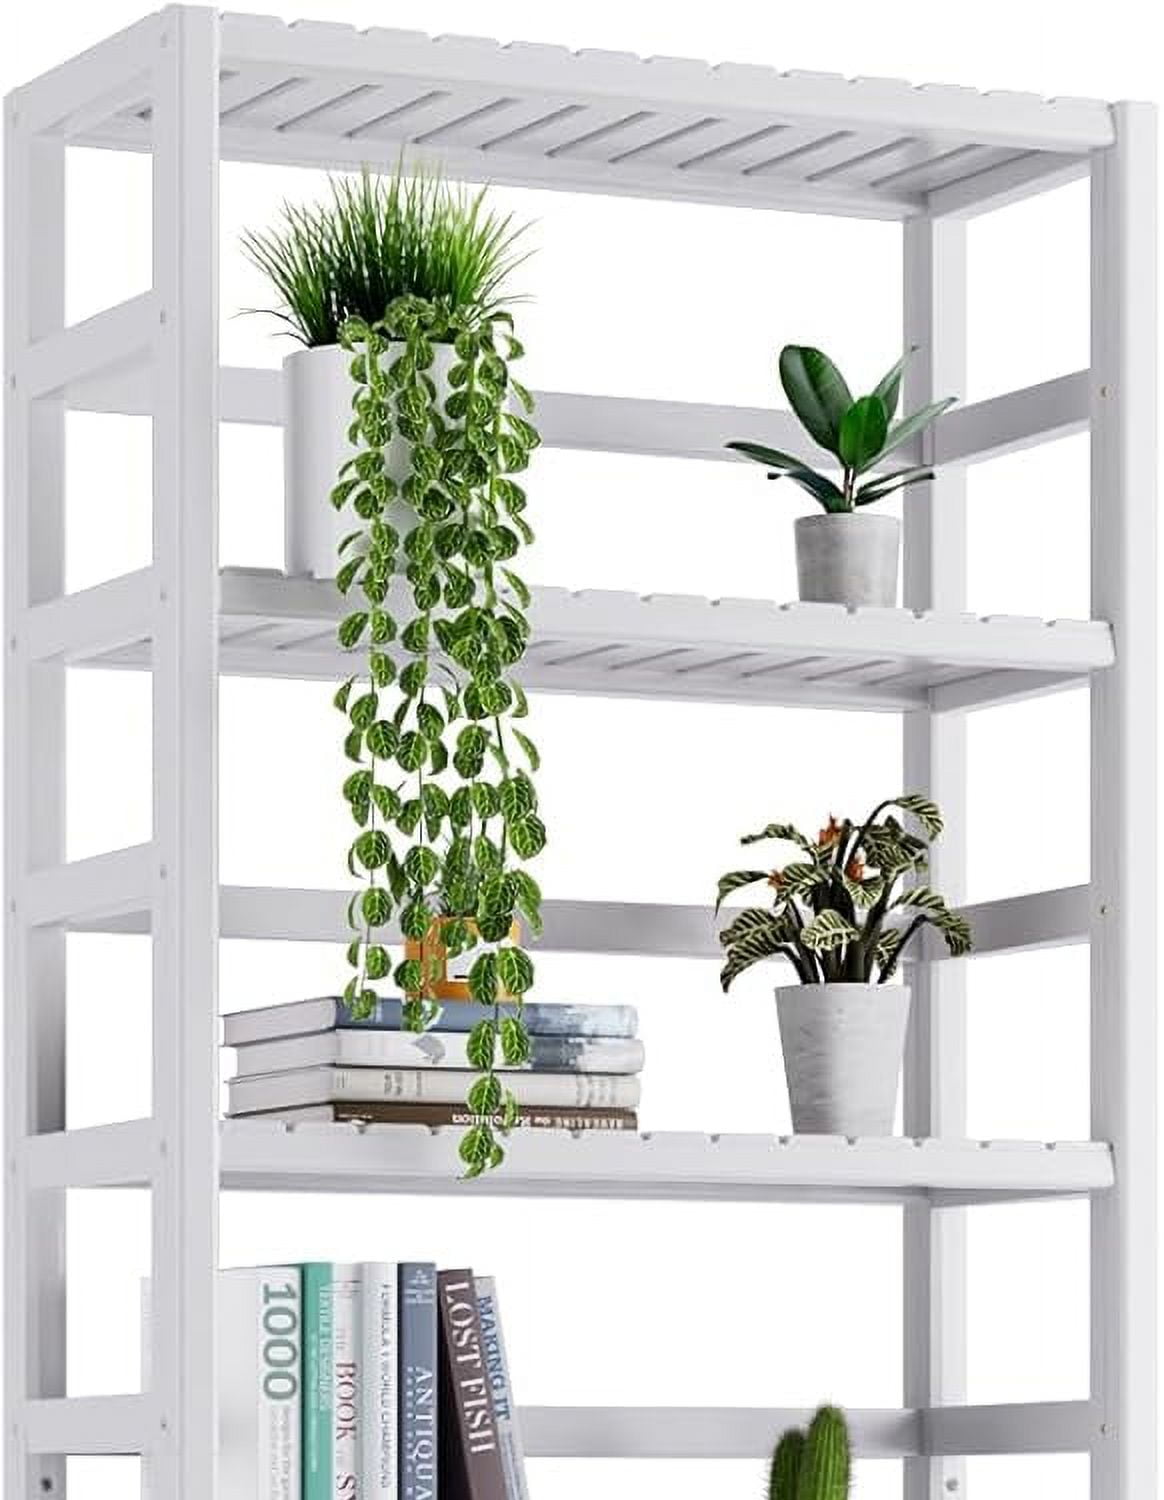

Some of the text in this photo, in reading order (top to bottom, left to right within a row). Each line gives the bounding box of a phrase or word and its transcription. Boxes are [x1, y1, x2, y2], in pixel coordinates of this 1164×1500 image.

[262, 1282, 297, 1401] 1000
[336, 1362, 357, 1440] BOOK
[444, 1282, 497, 1453] LOST FISH
[478, 1295, 511, 1422] MAKING IT
